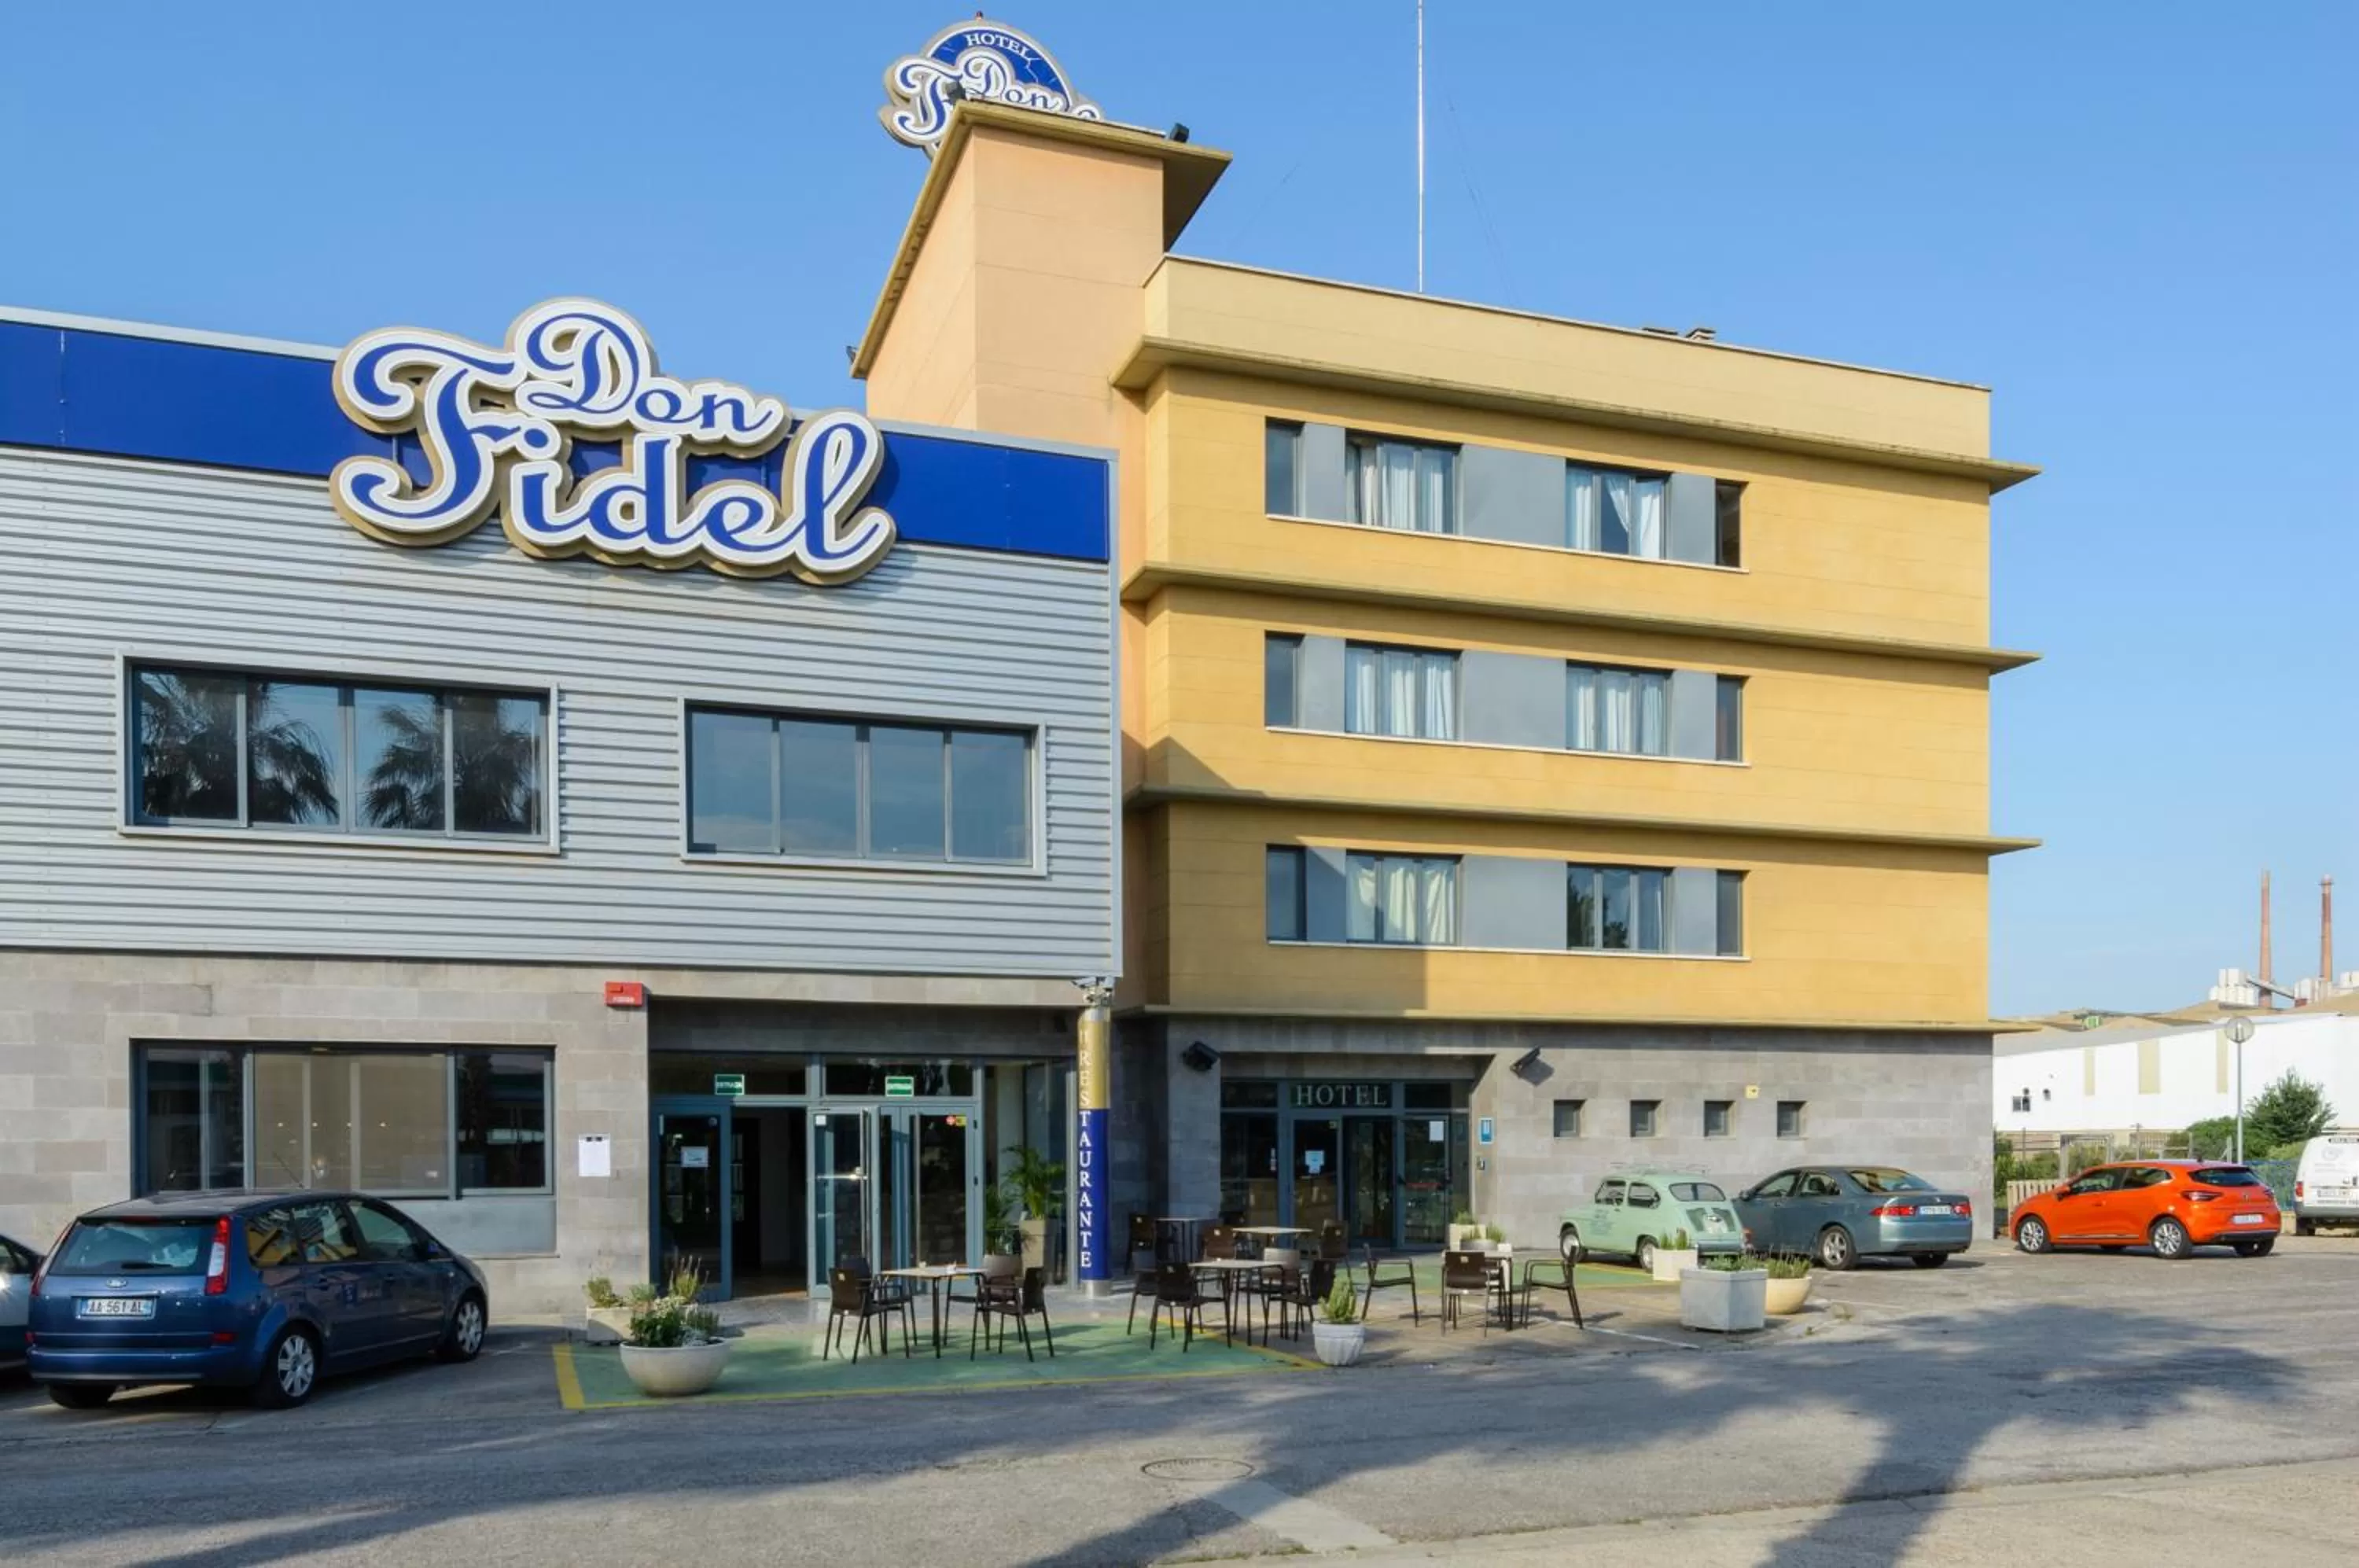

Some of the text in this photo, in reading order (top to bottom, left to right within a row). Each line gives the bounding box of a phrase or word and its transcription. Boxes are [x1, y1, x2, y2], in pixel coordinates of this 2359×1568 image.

[962, 33, 1031, 59] HOTEL
[963, 55, 1058, 109] Don
[524, 312, 772, 432] Don
[350, 342, 881, 561] Fidel
[1296, 1084, 1388, 1106] HOTEL
[1078, 1050, 1093, 1268] RESTAURANTE
